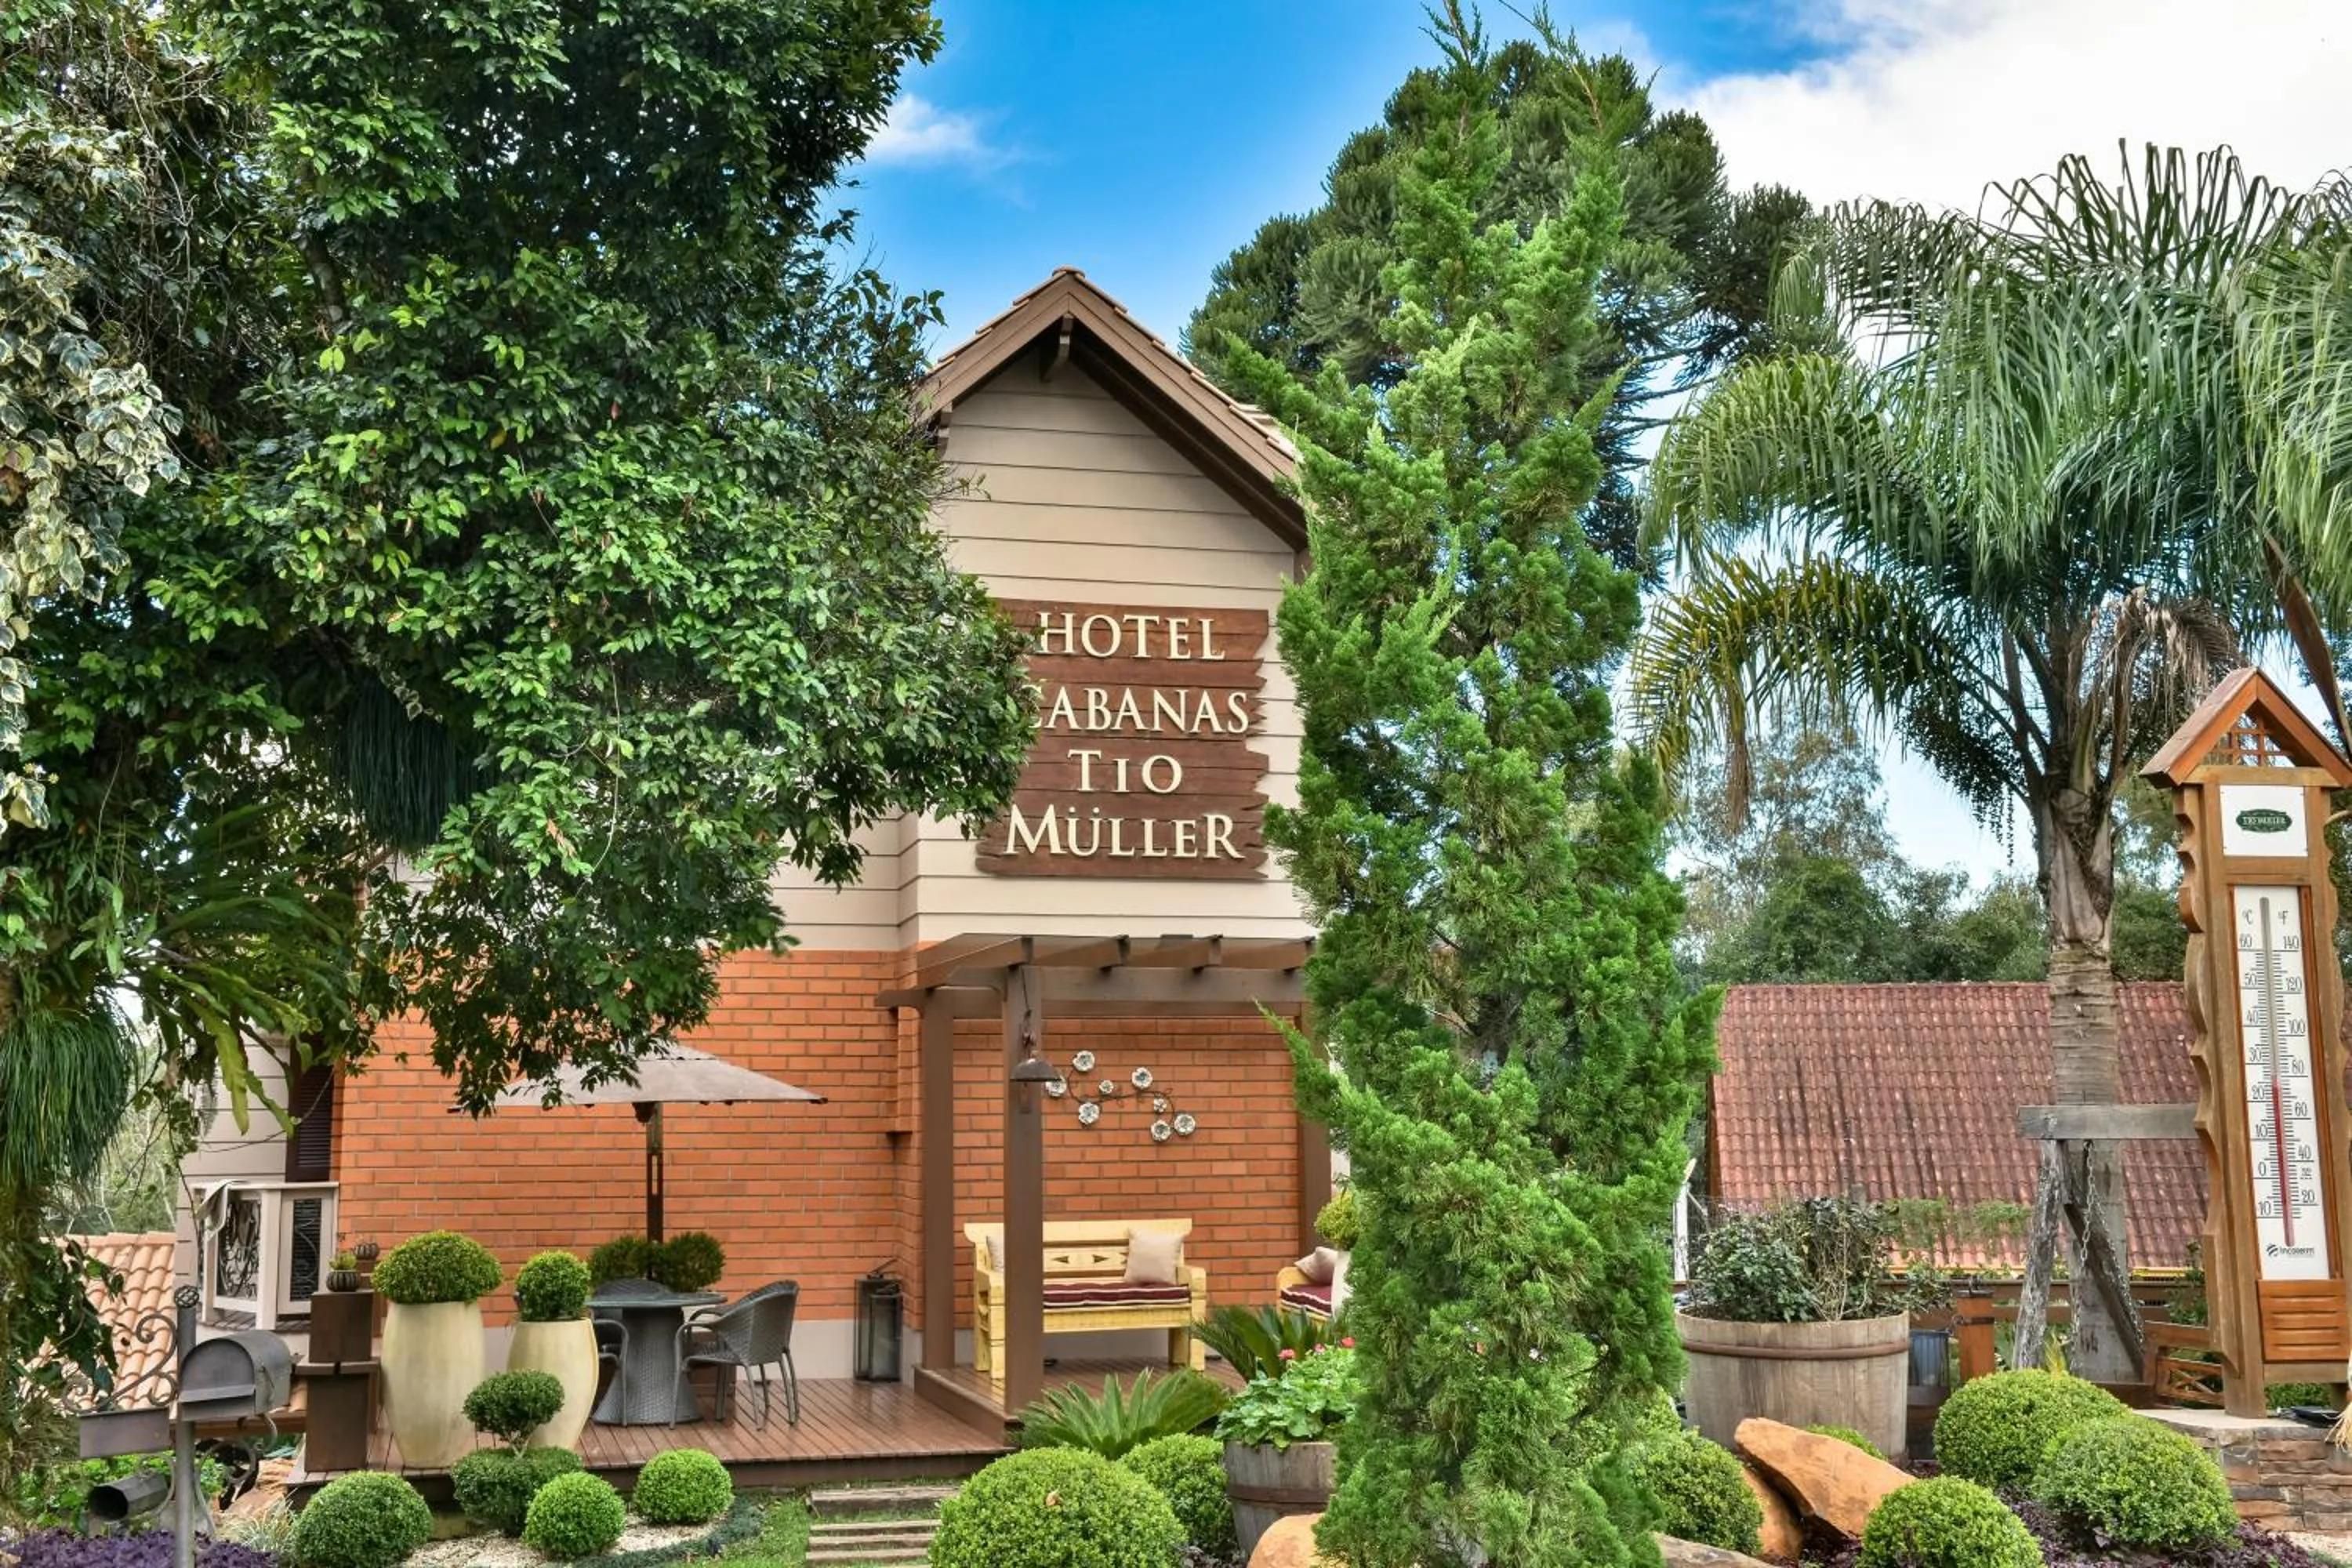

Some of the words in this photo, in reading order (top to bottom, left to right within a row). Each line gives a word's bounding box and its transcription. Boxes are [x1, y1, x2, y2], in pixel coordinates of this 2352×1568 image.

[1036, 611, 1225, 660] HOTEL
[1067, 749, 1184, 794] TIO
[1003, 803, 1245, 859] MÜLLER
[2283, 935, 2299, 949] 140
[2245, 974, 2256, 986] 50
[2247, 1011, 2259, 1024] 40
[2288, 1020, 2306, 1033] 100
[2249, 1047, 2262, 1062] 30
[2292, 1060, 2305, 1074] 80
[2252, 1085, 2264, 1099] 20
[2256, 1124, 2267, 1138] 10
[2298, 1145, 2311, 1159] 40
[2258, 1162, 2267, 1177] 0
[2302, 1190, 2314, 1203] 20
[2258, 1202, 2270, 1216] 10
